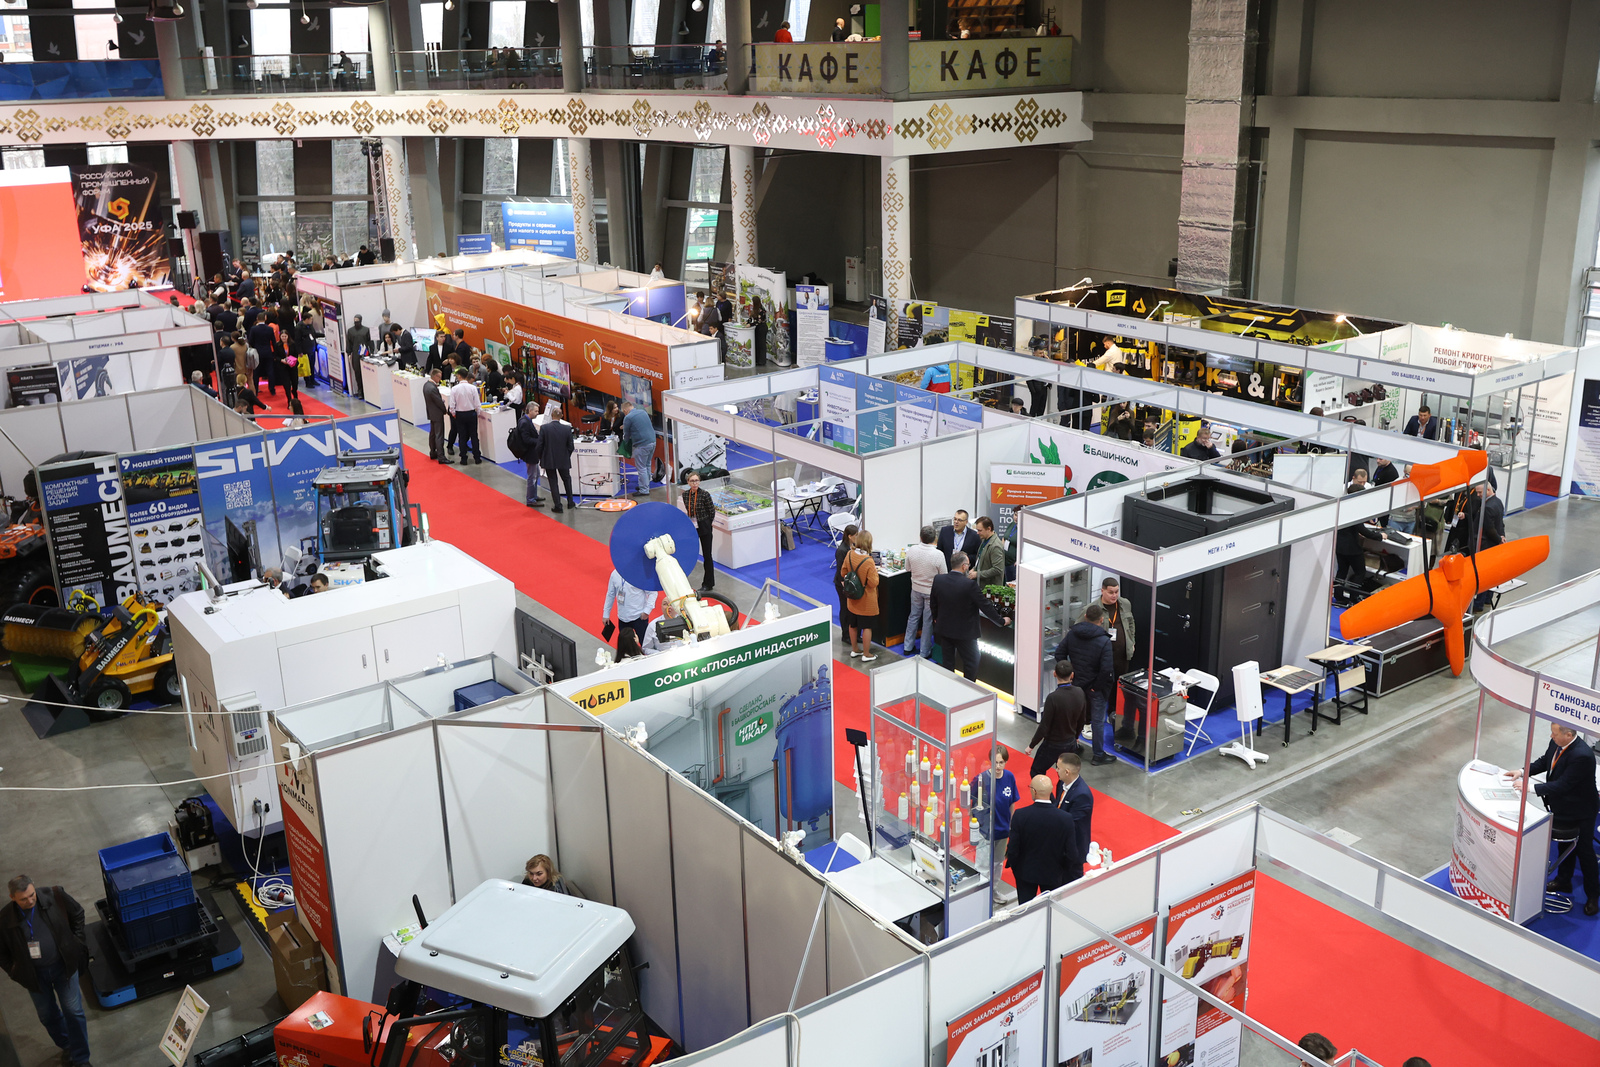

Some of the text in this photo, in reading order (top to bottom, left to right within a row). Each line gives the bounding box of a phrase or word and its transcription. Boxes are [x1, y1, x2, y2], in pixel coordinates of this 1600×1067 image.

[778, 52, 859, 84] КАФЕ
[940, 47, 1042, 81] КАФЕ
[80, 170, 133, 180] РОССИЙСКИЙ
[81, 176, 150, 188] ПРОМЫШЛЕННЫЙ
[92, 221, 153, 234] УФА 2025
[514, 328, 534, 340] СДЕЛАНО
[536, 335, 564, 350] РЕСПУБЛИКЕ
[1432, 356, 1457, 367] ЛЮБОЙ
[1433, 347, 1493, 363] РЕМОНТ КРИОГЕН
[601, 355, 625, 368] СДЕЛАНО
[629, 363, 664, 380] РЕСПУБЛИКЕ
[1247, 372, 1265, 399] &
[121, 453, 193, 470] 9 МОДЕЛЕЙ ТЕХНИКИ
[1090, 447, 1139, 467] БАШИНКОМ
[1013, 469, 1046, 477] БАШИНКОМ
[44, 477, 89, 490] КОМПАКТНЫЕ
[45, 485, 78, 496] РЕШЕНИЯ
[46, 491, 79, 501] БОЛЬШИХ
[47, 498, 69, 507] ЗАДАЧ
[129, 501, 188, 518] БОЛЕЕ 60 ВИДОВ
[130, 507, 200, 524] НАВЕСНОГО ОБОРУДОВАНИЯ
[94, 459, 138, 601] BAUMECH
[1070, 537, 1084, 547] МЕГИ
[1089, 543, 1100, 553] УФА
[1207, 546, 1220, 556] МЕГИ
[1225, 541, 1236, 551] УФА
[3, 615, 35, 625] BAUMECH
[95, 637, 128, 671] BAUMECH
[654, 632, 819, 688] ООО ГК «ГЛОБАЛ ИНДАСТРИ»
[1542, 682, 1551, 691] 72
[574, 687, 625, 711] ЛОБАЛ
[738, 694, 763, 714] СДЕЛАНО
[734, 693, 776, 725] БАШКОРТОСТАНЕ
[1554, 702, 1581, 720] БОРЕЦ
[738, 720, 758, 737] НПП
[741, 723, 768, 743] ИКАР
[962, 722, 984, 735] ГЛОБАЛ
[1170, 901, 1201, 923] КУЗНЕЧНЫЙ
[1200, 891, 1227, 908] КОМПЛЕКС
[1226, 884, 1243, 896] СЕРИИ
[950, 1021, 973, 1039] СТАНОК
[973, 996, 1011, 1025] ЗАКАЛОЧНЫЙ
[1011, 986, 1029, 1003] СЕРИИ
